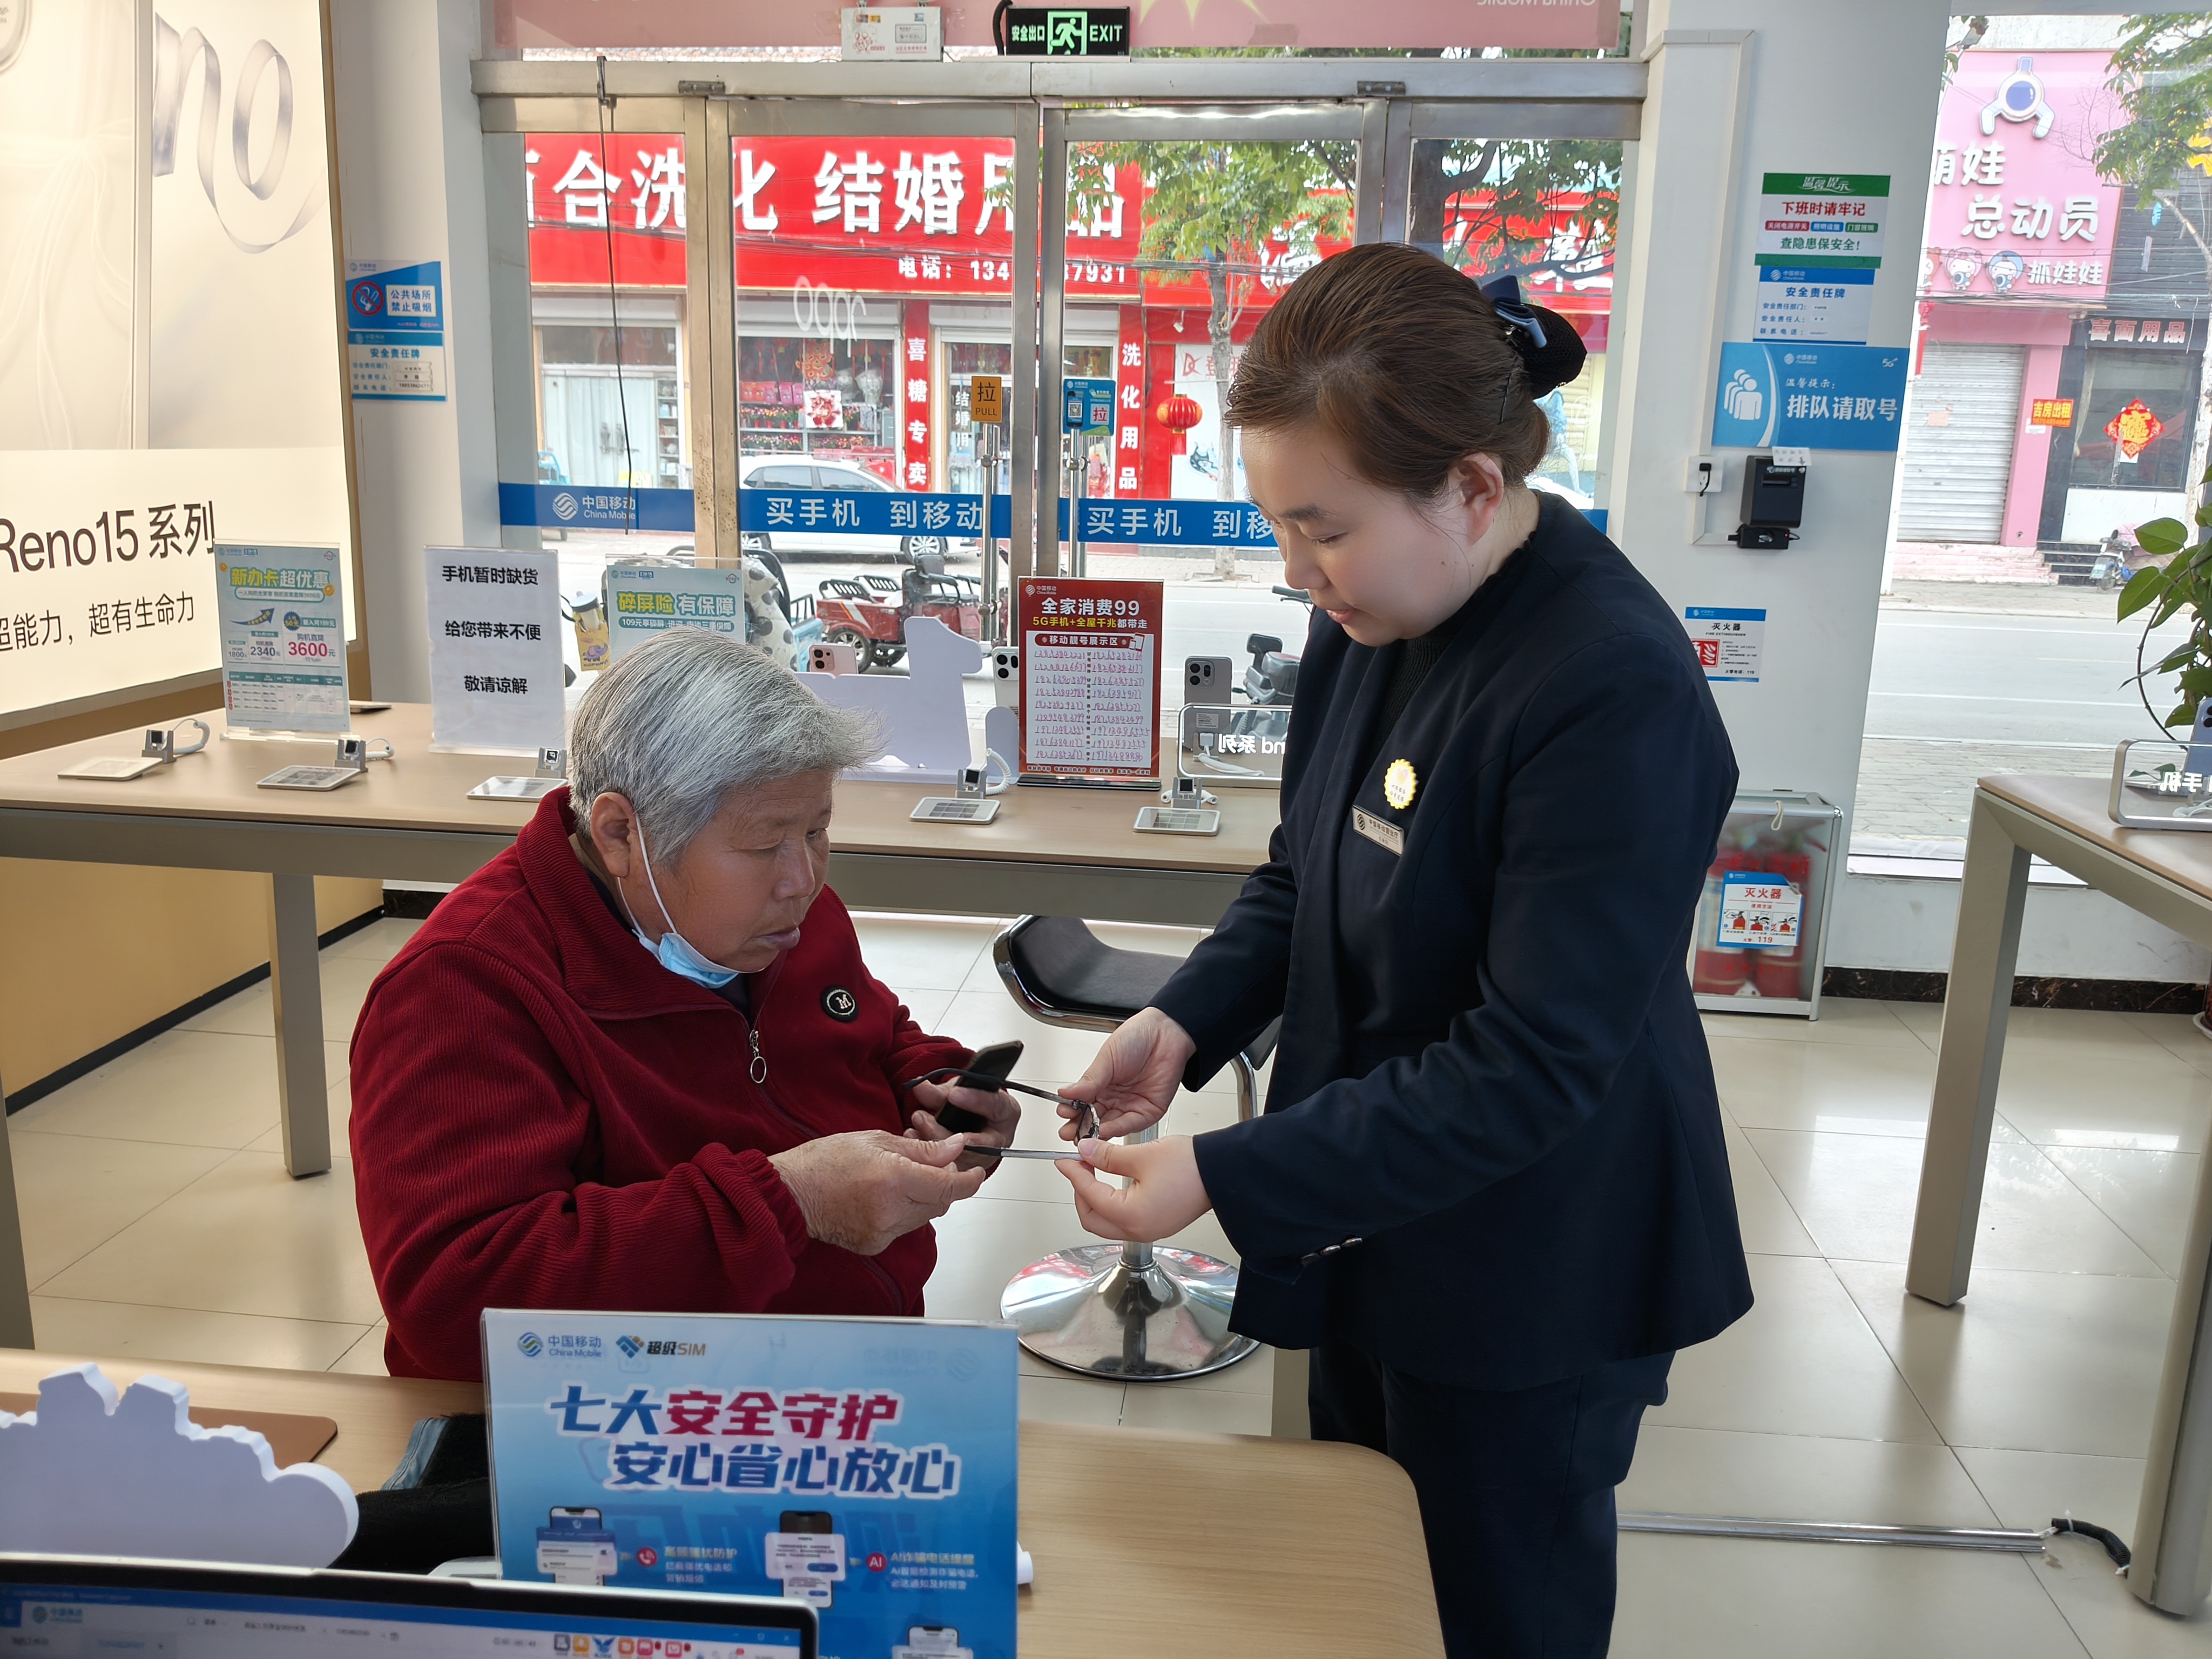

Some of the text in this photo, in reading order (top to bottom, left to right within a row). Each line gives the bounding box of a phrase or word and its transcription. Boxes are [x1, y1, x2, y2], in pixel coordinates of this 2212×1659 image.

[1011, 25, 1123, 42] 安全出口 EXIT
[1803, 176, 1851, 192] 温馨提示
[1782, 201, 1866, 217] 下班时请牢记
[1961, 194, 2099, 242] 总动员
[1780, 237, 1860, 251] 查隐患保安全！
[2027, 260, 2103, 286] 抓娃娃
[390, 289, 430, 300] 公共场所
[1786, 287, 1845, 299] 安全责任牌
[392, 302, 432, 313] 禁止吸烟
[370, 348, 420, 359] 安全责任牌
[977, 382, 996, 402] 拉
[907, 337, 928, 485] 喜糖专卖
[975, 407, 998, 416] PULL
[1093, 407, 1107, 422] 拉
[1118, 342, 1142, 490] 洗化用品
[1786, 395, 1898, 422] 排队请取号
[2033, 401, 2072, 419] 吉房出租
[582, 496, 636, 510] 中国移动
[584, 509, 607, 519] China
[766, 497, 983, 531] 买手机 到移动
[1087, 507, 1182, 537] 买手机
[0, 500, 215, 574] Reno15 系列
[231, 568, 329, 589] 新办卡超优惠
[442, 565, 539, 586] 手机暂时缺货
[618, 592, 734, 616] 碎屏险 有保障
[1041, 597, 1140, 616] 全家消费99
[1033, 616, 1148, 629] 5G手机+全屋千兆都带走
[1712, 623, 1741, 631] 灭火器
[445, 621, 542, 642] 给您带来不便
[288, 641, 336, 657] 3600元
[1049, 635, 1118, 646] 移动靓号展示区
[464, 675, 529, 695] 敬请谅解
[1744, 887, 1782, 899] 灭火器
[548, 1335, 706, 1356] 中国移动 超级SIM
[549, 1348, 602, 1358] China Mobile
[550, 1385, 900, 1442] 七大安全守护
[610, 1442, 955, 1494] 安心省心放心
[869, 1557, 882, 1567] AI
